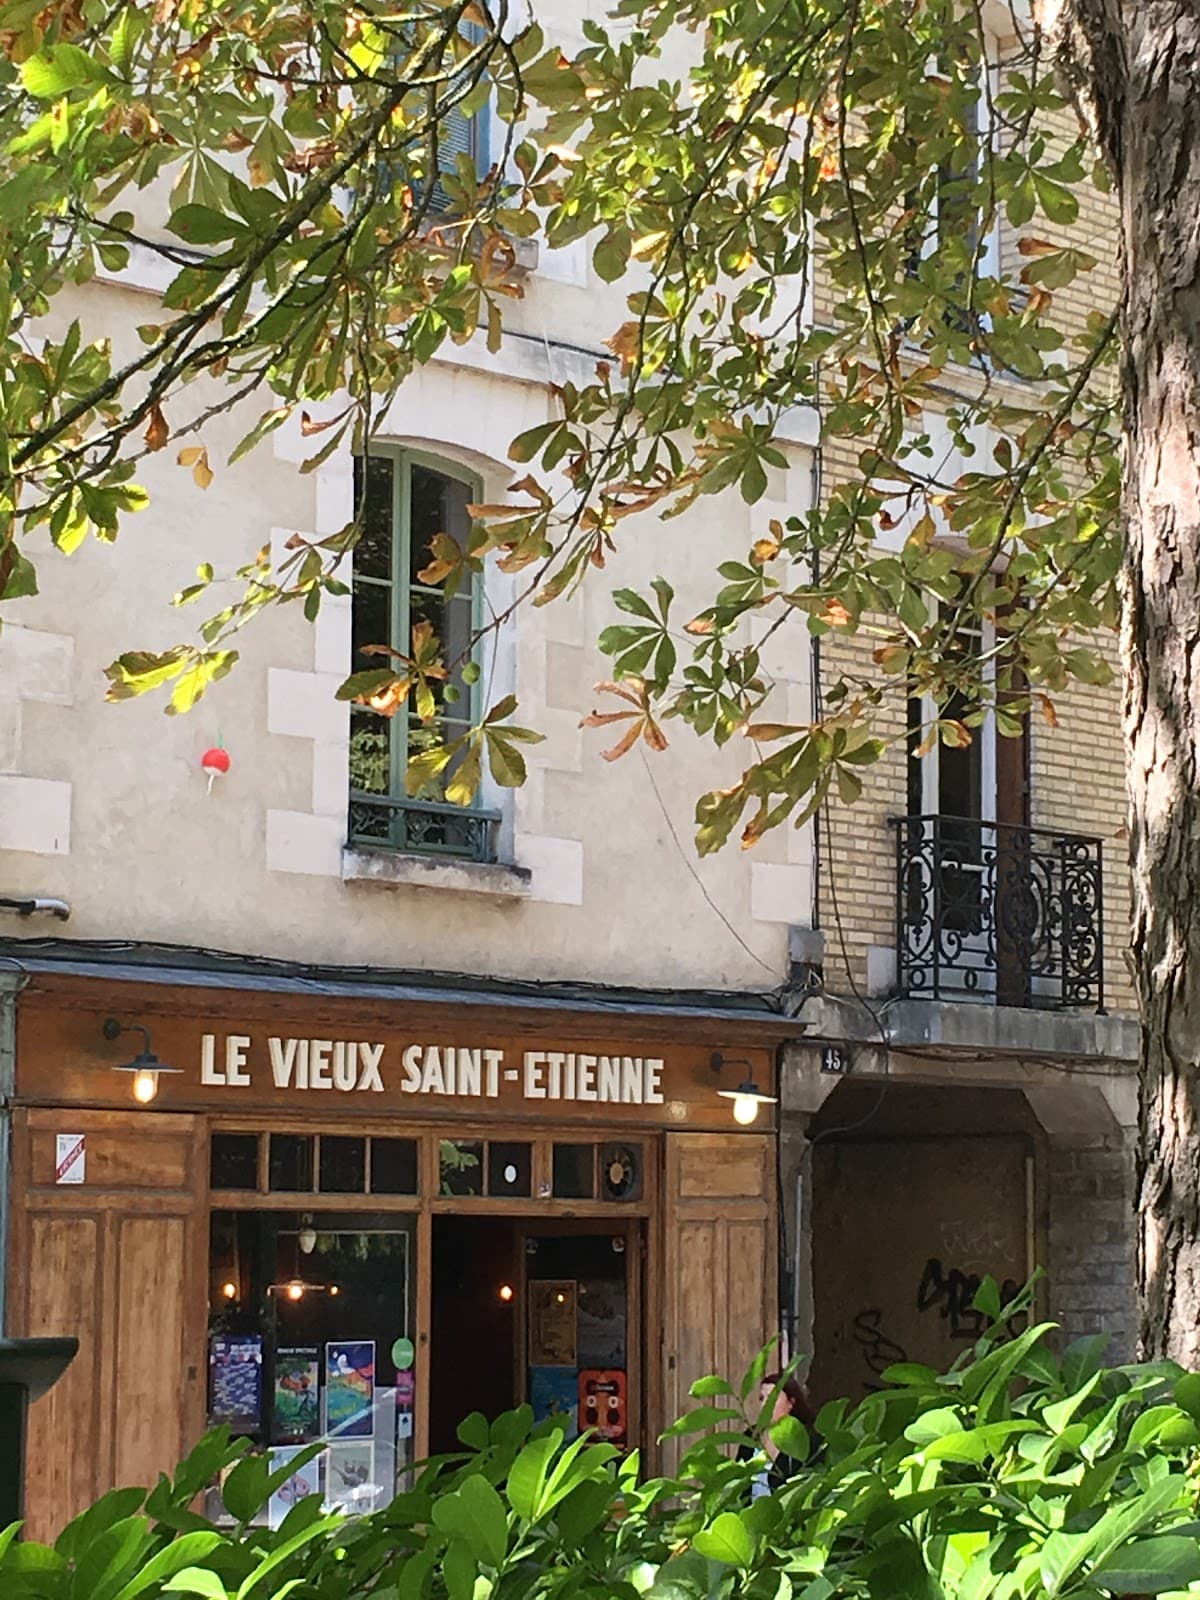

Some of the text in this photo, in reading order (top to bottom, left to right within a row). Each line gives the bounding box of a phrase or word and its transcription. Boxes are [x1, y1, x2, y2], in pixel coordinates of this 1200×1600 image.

[201, 1034, 665, 1104] LE VIEUX SAINT-ETIENNE
[825, 1049, 841, 1070] 45
